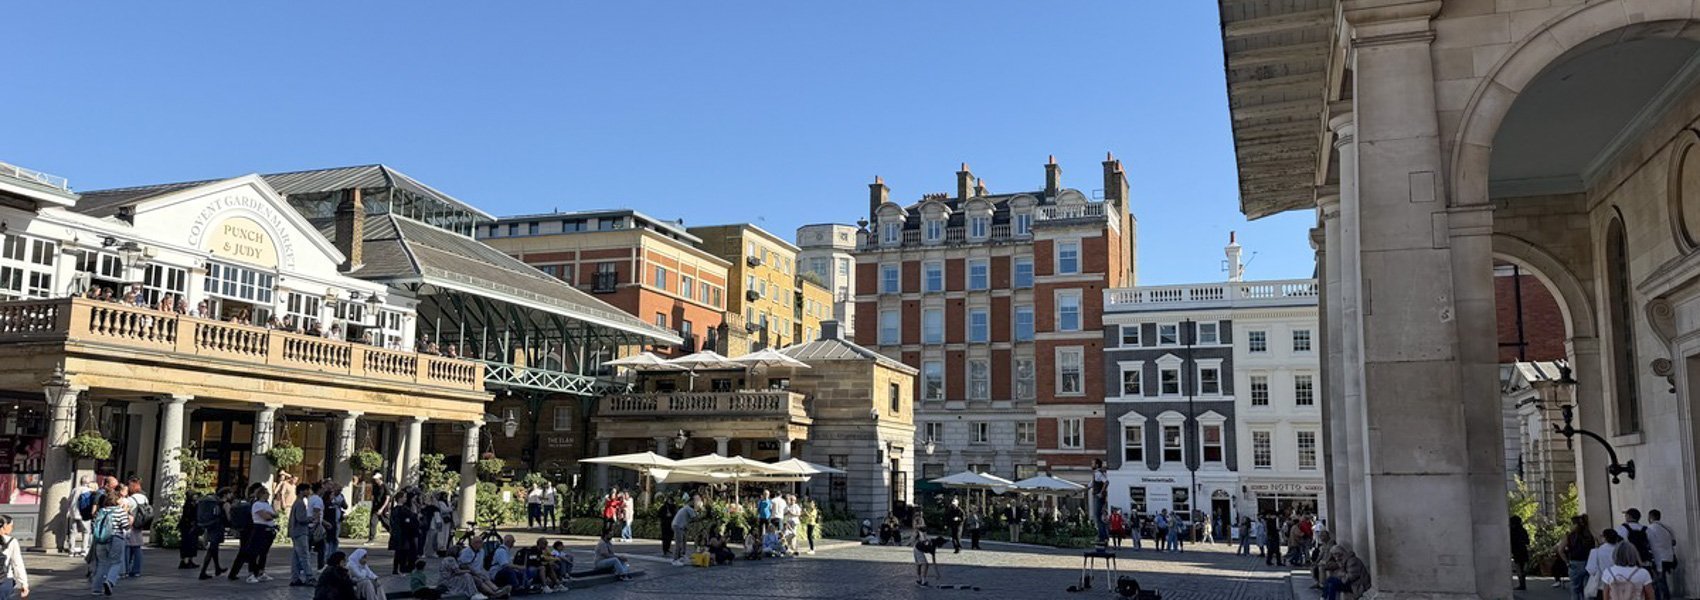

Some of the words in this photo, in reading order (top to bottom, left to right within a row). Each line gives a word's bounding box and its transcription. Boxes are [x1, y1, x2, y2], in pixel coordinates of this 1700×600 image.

[188, 199, 222, 246] COVENT
[224, 195, 273, 218] GARDEN
[270, 214, 295, 271] MARKET
[224, 224, 263, 244] PUNCH
[223, 241, 231, 251] &
[232, 243, 262, 259] JUDY
